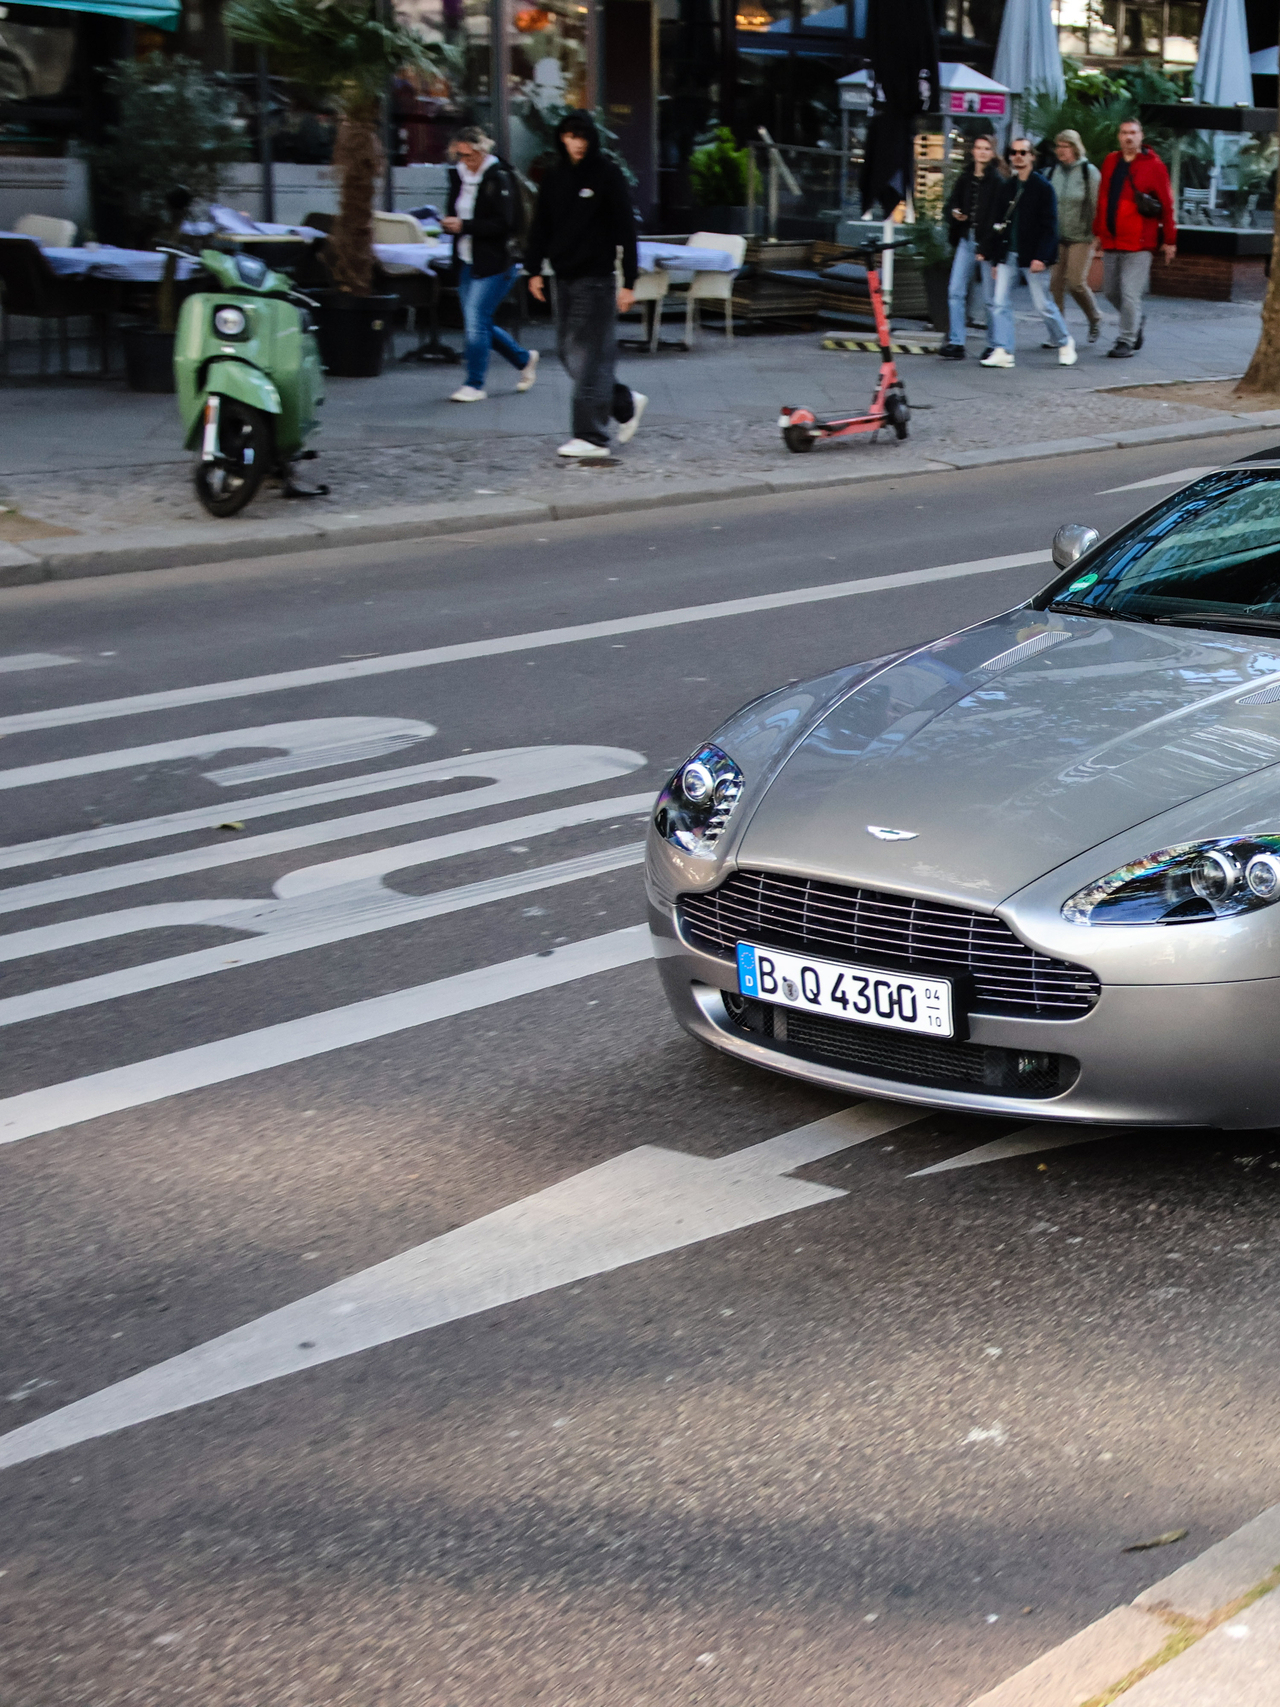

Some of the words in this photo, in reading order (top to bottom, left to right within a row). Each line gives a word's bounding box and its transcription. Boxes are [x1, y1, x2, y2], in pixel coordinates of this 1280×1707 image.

[745, 974, 754, 987] D
[758, 955, 778, 995] B
[801, 966, 822, 1006] Q
[831, 972, 918, 1023] 4300
[925, 988, 941, 1001] 04
[928, 1015, 942, 1028] 10
